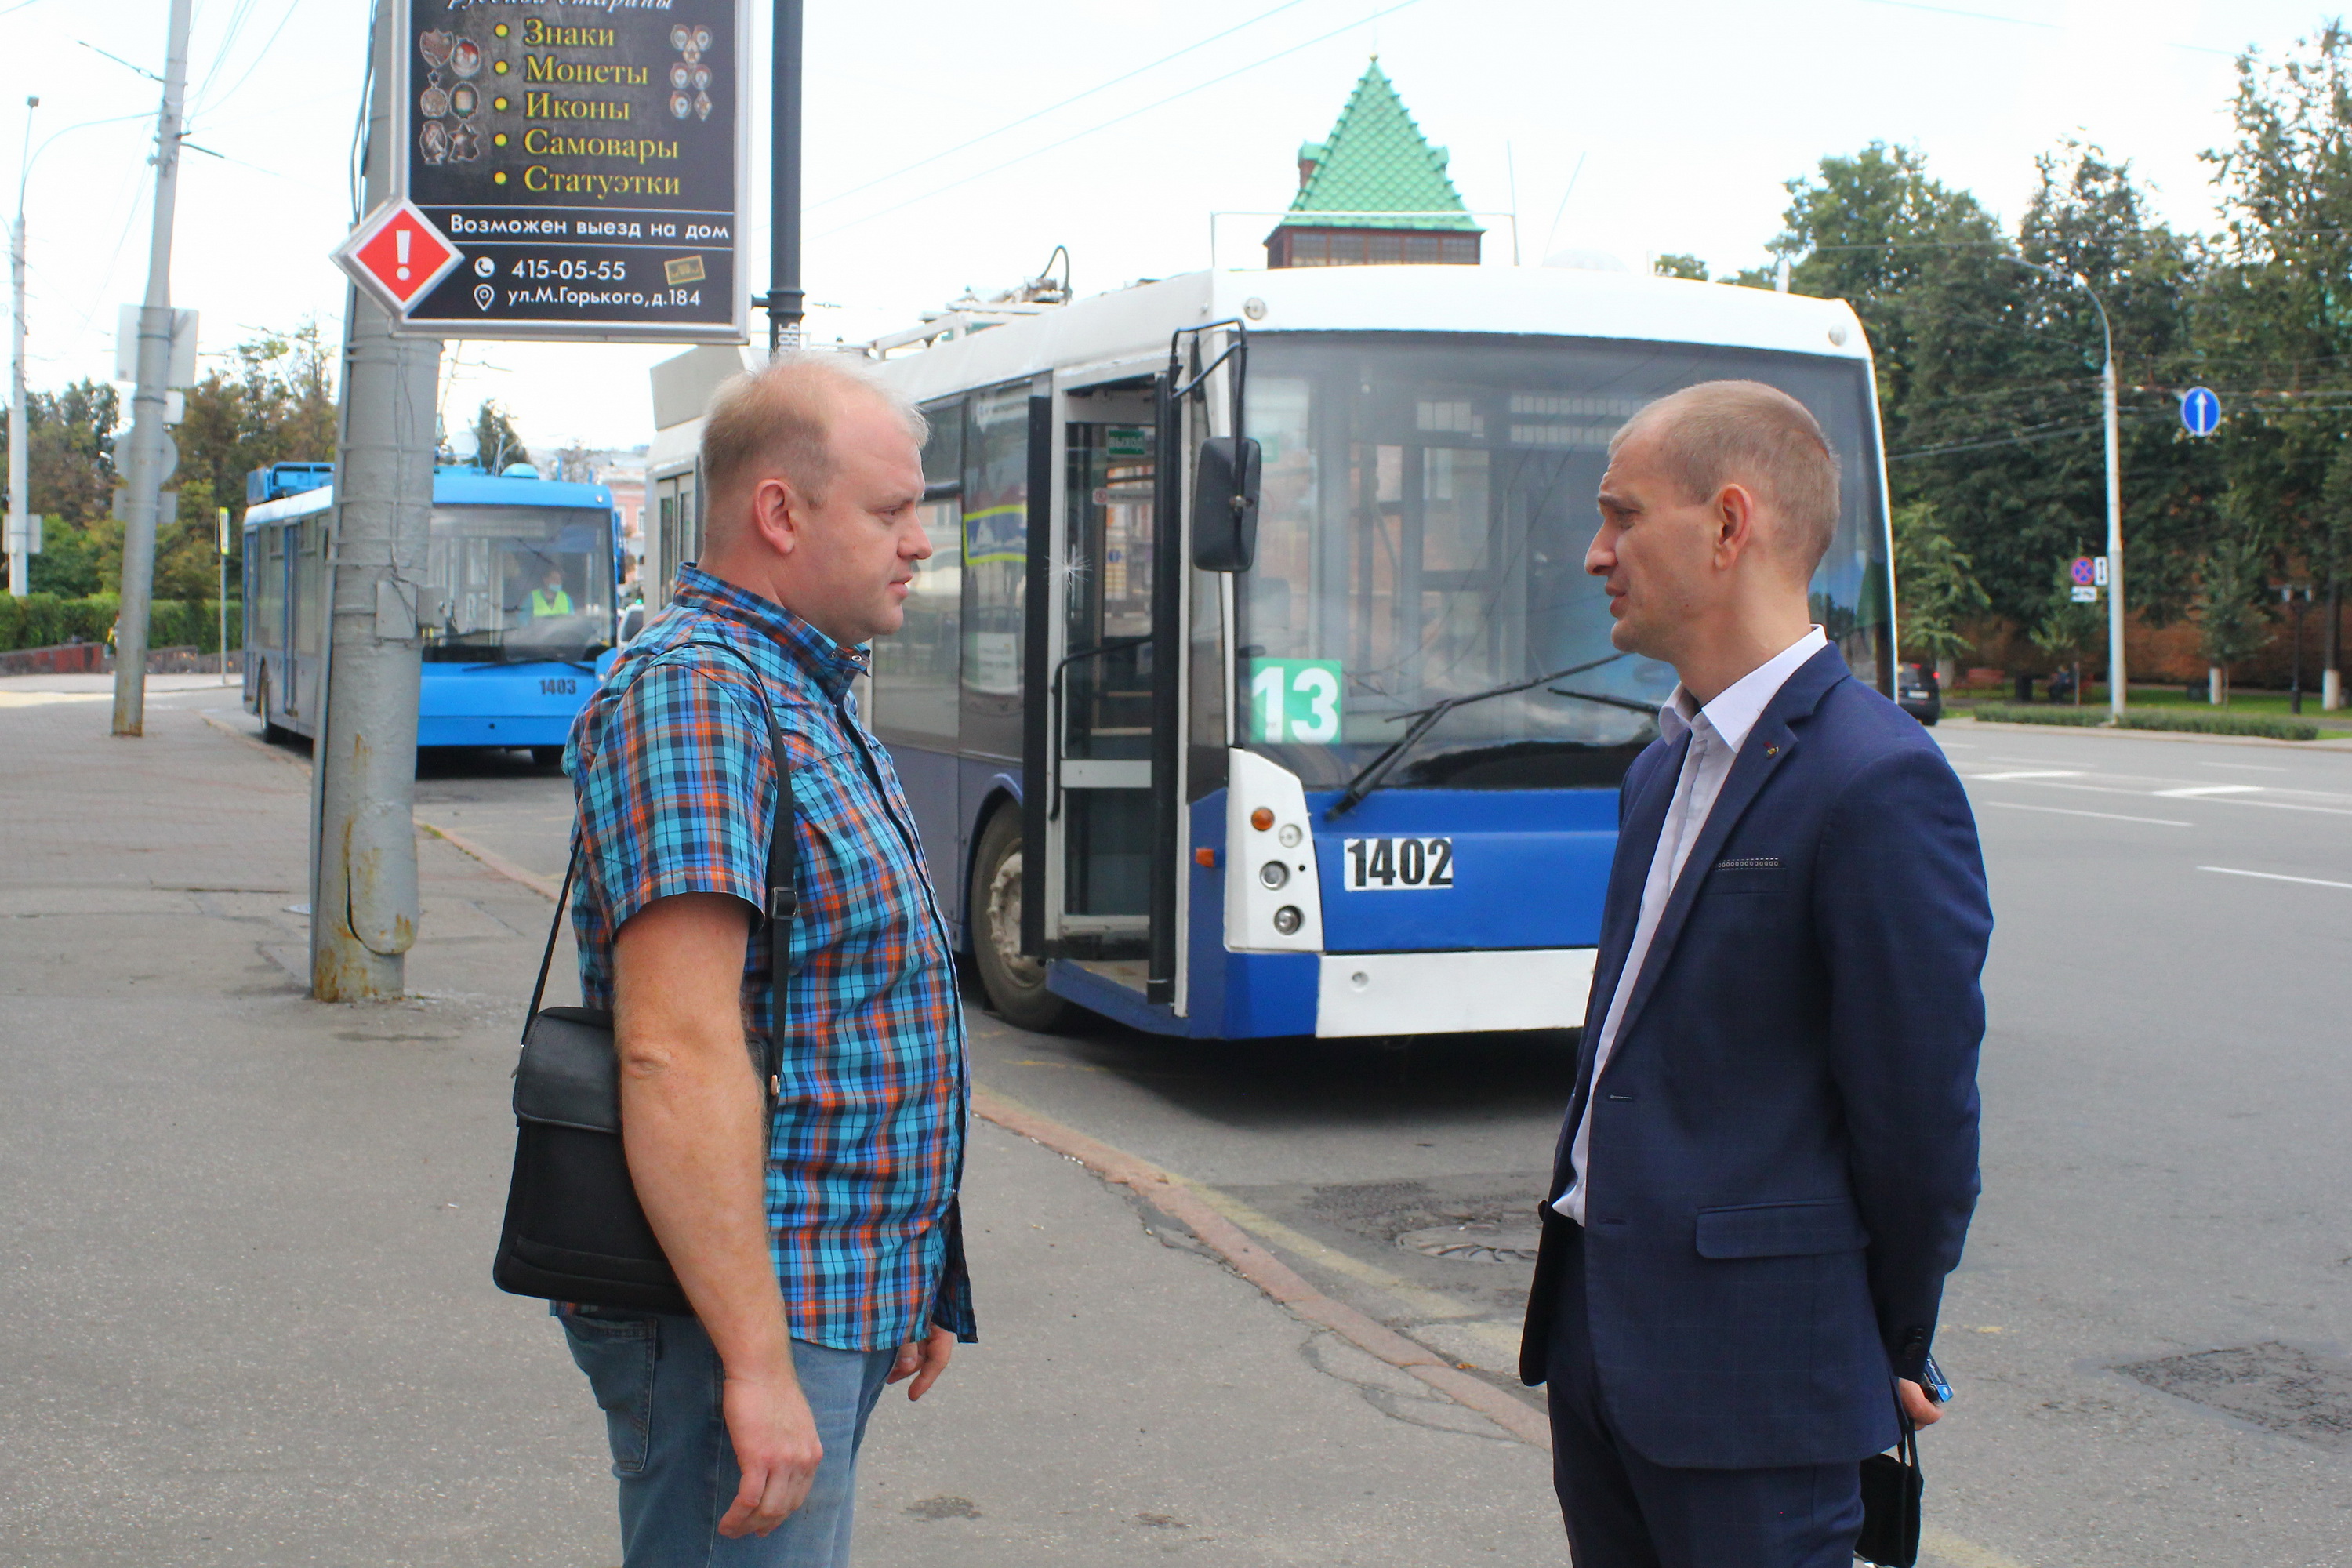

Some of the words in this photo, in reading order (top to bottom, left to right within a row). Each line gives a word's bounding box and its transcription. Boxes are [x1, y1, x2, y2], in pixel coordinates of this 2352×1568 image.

[524, 17, 615, 47] Знаки
[525, 55, 649, 85] Монеты
[525, 92, 630, 120] Иконы
[524, 128, 679, 164] Самовары
[524, 165, 681, 200] Статуэтки
[450, 214, 567, 235] Возможен
[576, 221, 641, 238] выезд
[651, 223, 677, 238] на
[685, 224, 730, 239] дом
[510, 259, 626, 281] 415-05-55
[539, 678, 578, 695] 1403
[1252, 666, 1339, 744] 13
[1347, 838, 1453, 887] 1402
